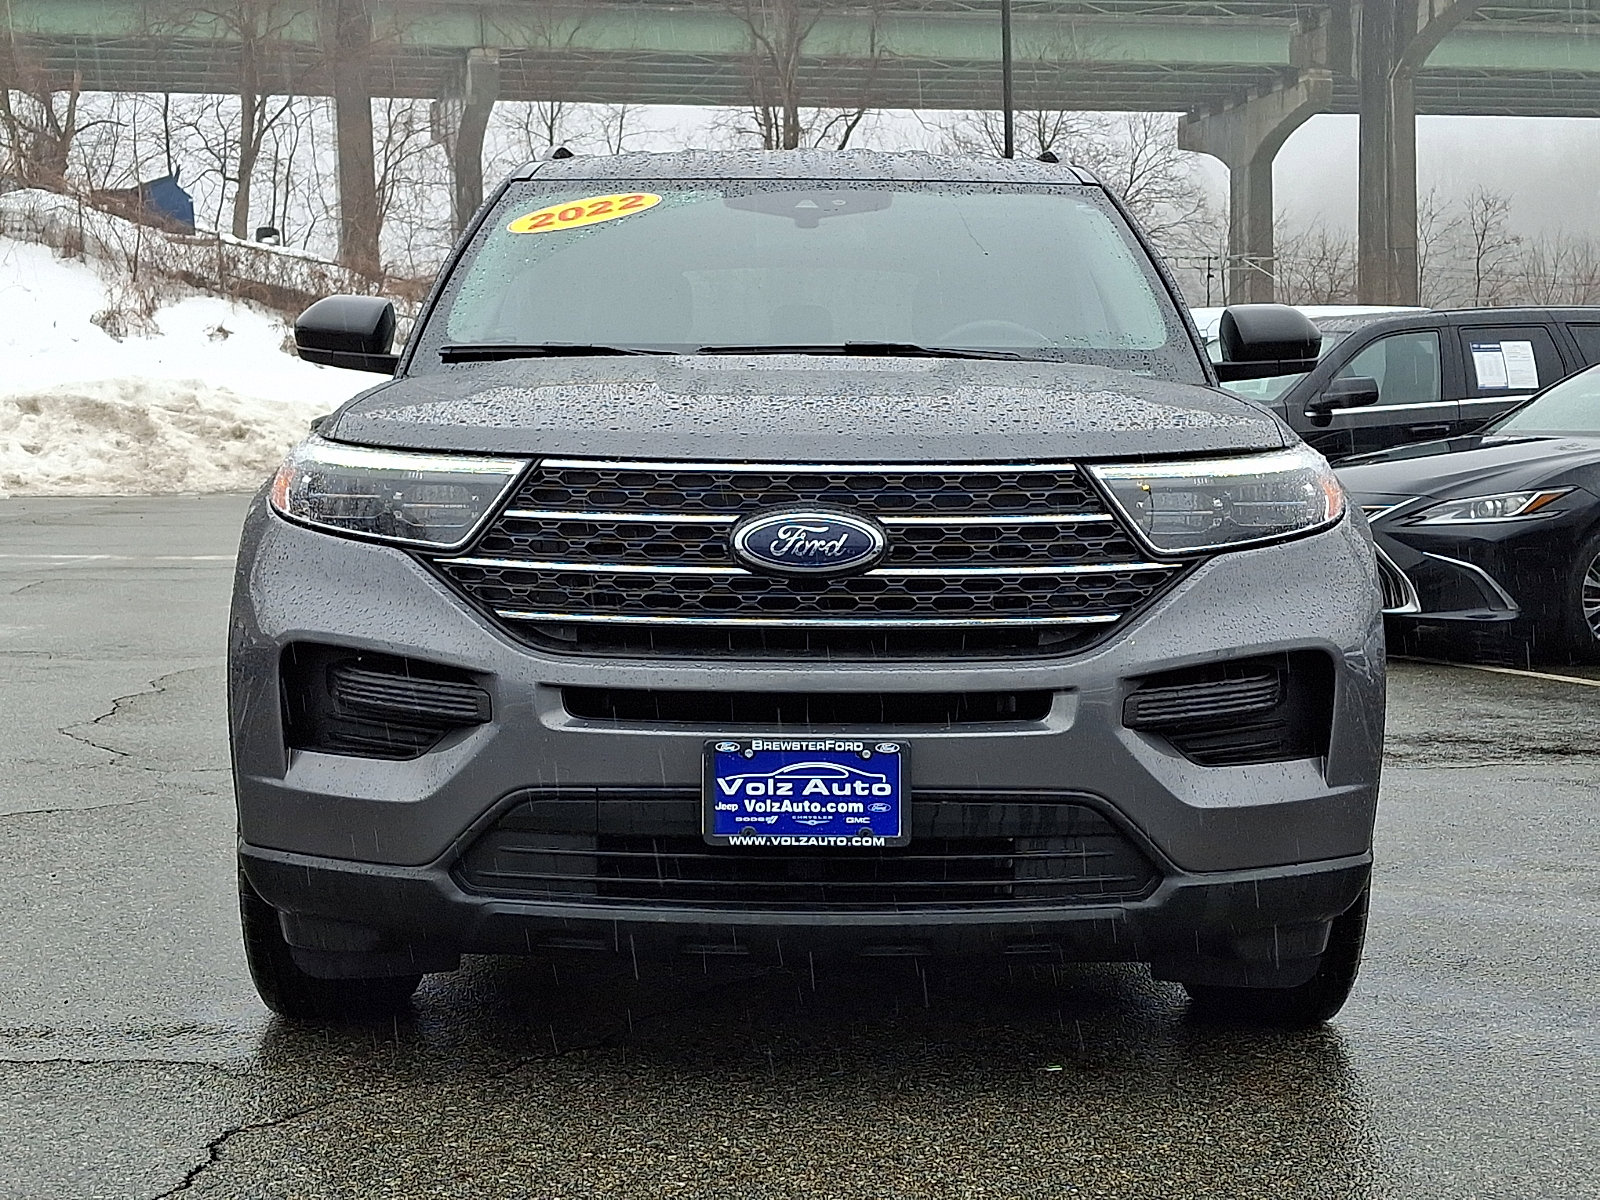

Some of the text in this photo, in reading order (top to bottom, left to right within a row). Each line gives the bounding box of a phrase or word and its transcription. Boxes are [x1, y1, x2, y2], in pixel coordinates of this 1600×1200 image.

[527, 195, 645, 230] 2022
[770, 525, 849, 556] Ford
[716, 778, 892, 796] Volz Auto
[714, 801, 738, 812] Jeep
[743, 800, 864, 812] VolzAuto.com
[845, 816, 871, 824] GMC
[729, 837, 885, 846] WWW.VOLZAUTO.COM
